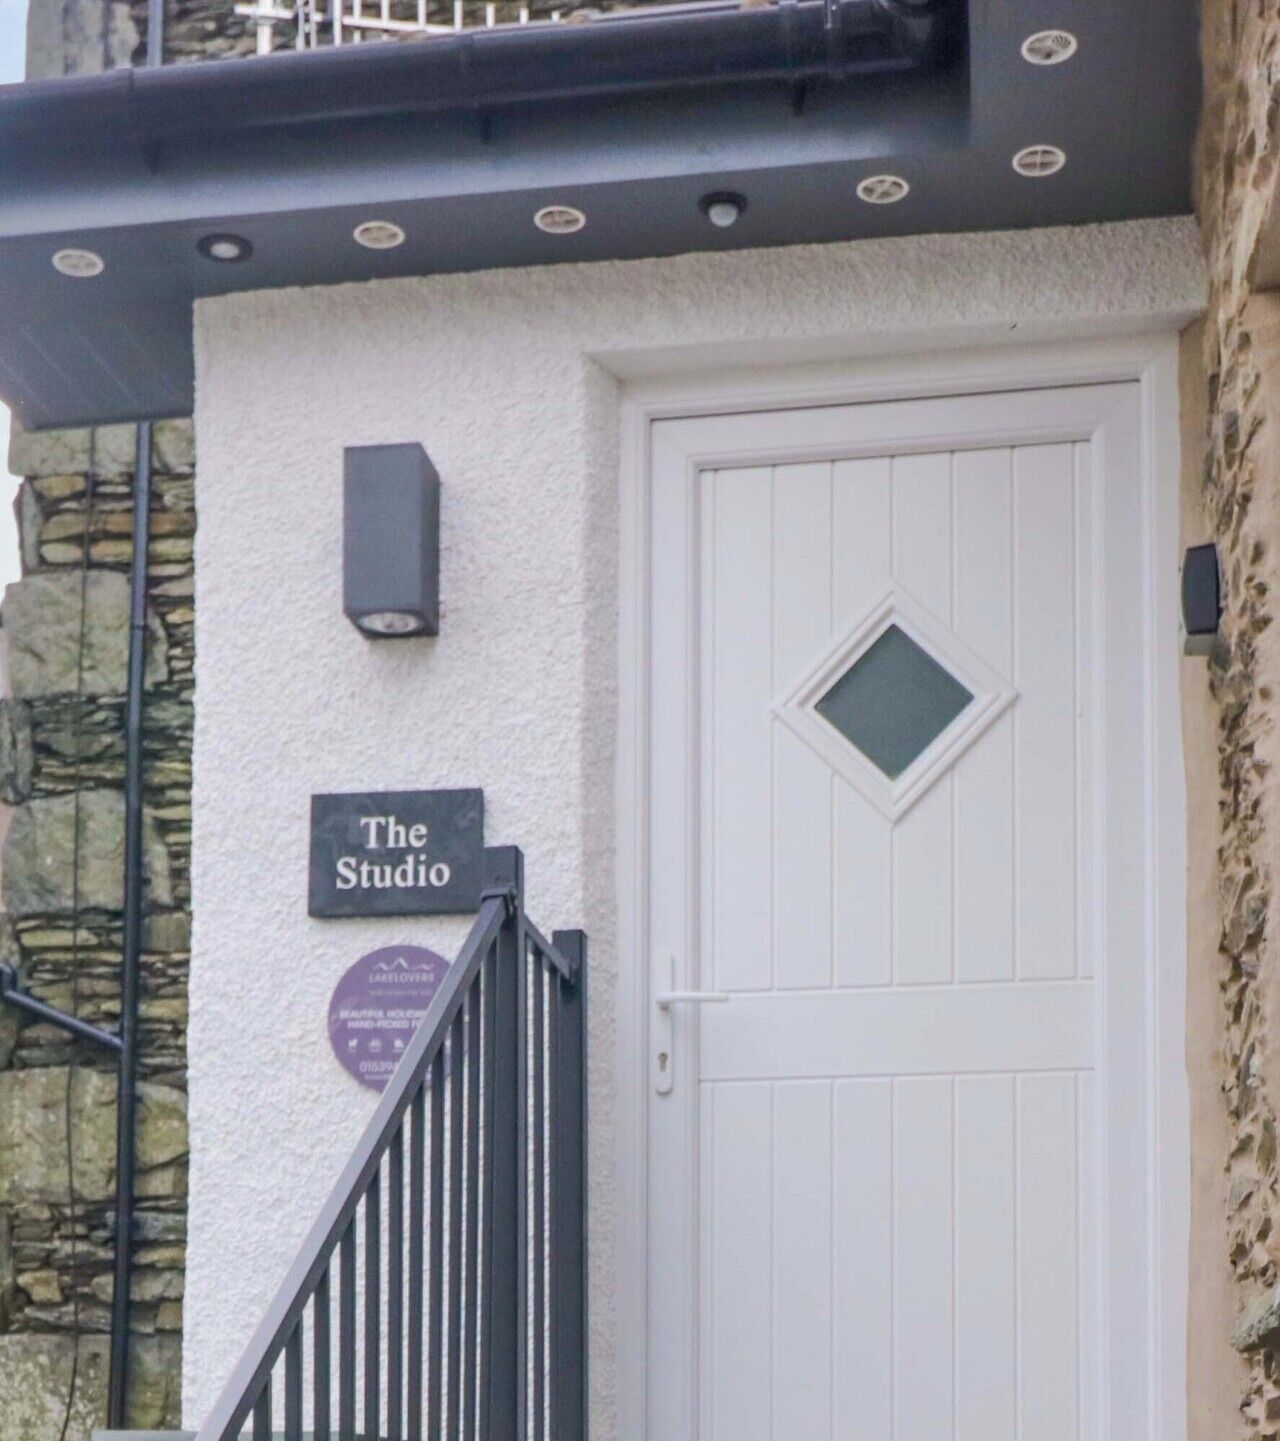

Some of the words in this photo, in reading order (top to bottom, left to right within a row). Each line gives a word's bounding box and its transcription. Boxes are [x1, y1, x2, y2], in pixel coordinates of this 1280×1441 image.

[360, 815, 428, 849] The
[336, 854, 450, 889] Studio
[369, 972, 435, 983] LAKELOVERS
